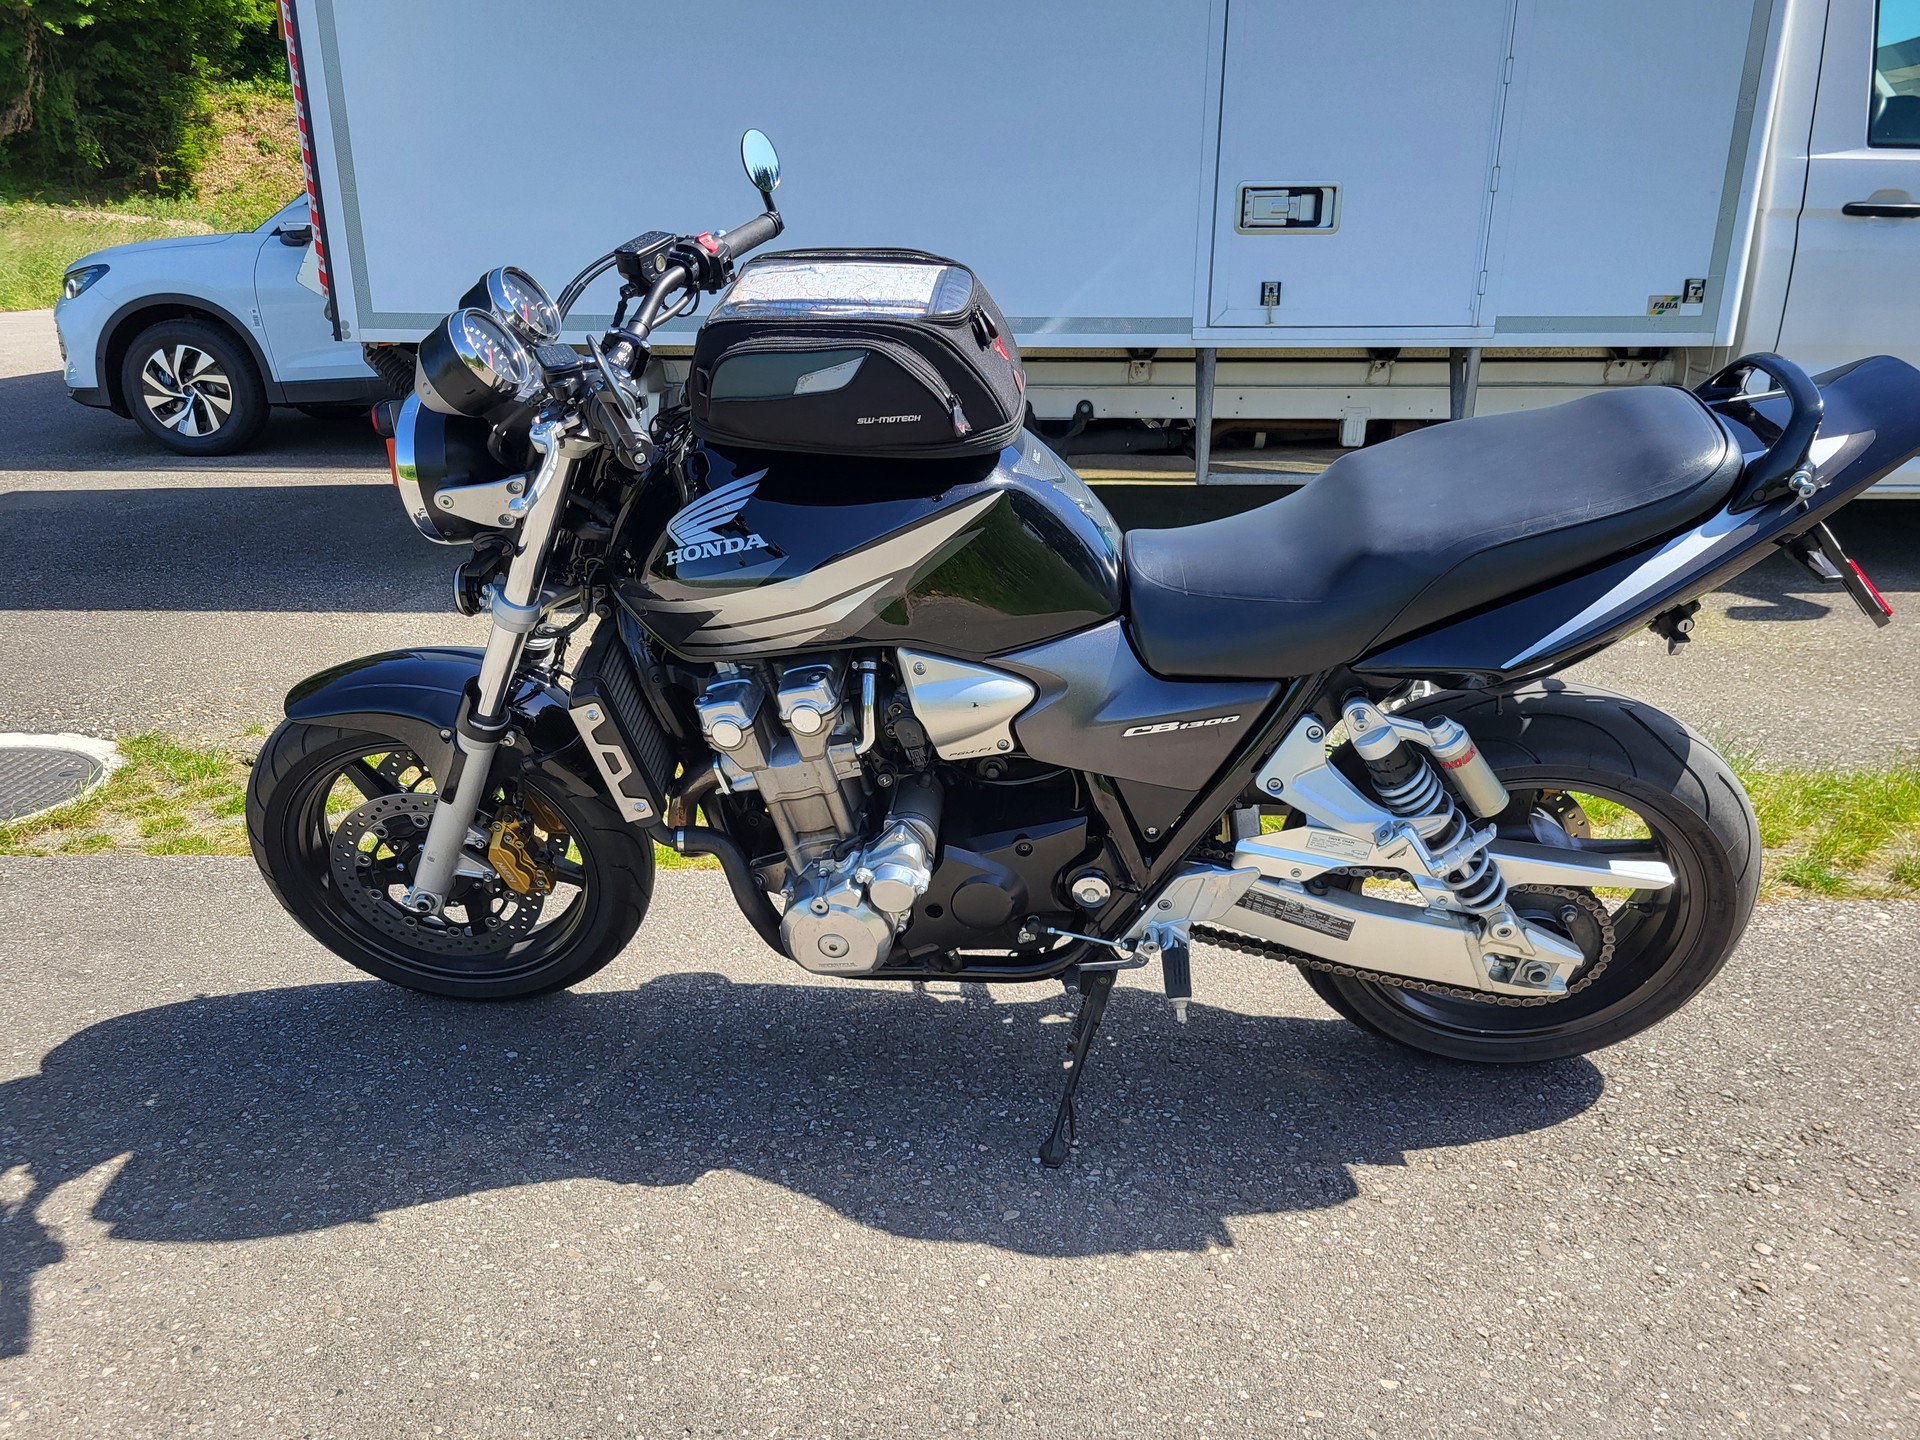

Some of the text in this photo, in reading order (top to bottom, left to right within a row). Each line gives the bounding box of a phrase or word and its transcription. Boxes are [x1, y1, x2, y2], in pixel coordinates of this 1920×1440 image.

[1653, 301, 1678, 310] FABA
[856, 414, 922, 425] SW-MOTECH
[666, 533, 769, 566] HONDA
